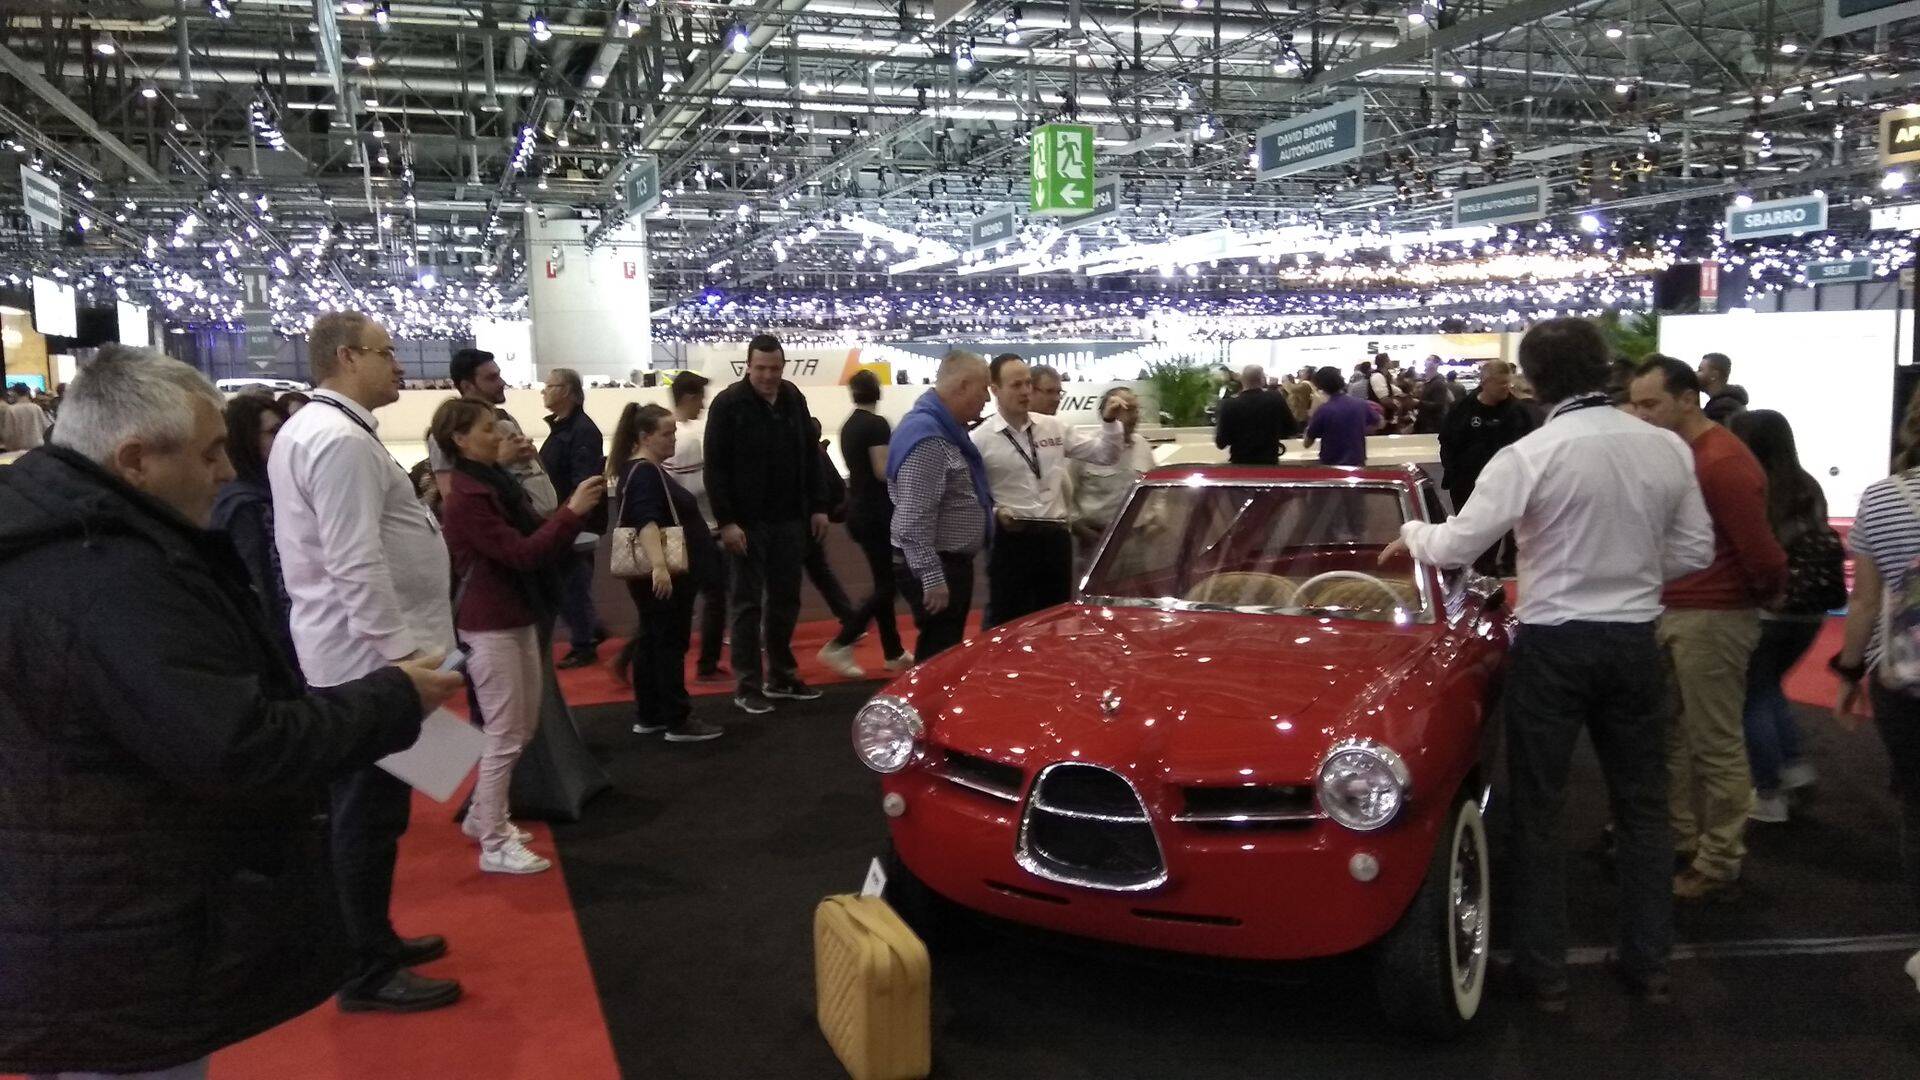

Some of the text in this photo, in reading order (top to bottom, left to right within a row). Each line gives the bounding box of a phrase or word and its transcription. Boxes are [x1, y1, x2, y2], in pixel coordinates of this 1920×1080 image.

[1277, 119, 1336, 147] DAVID BROWN
[1279, 136, 1334, 161] AUTOMOTIVE
[1744, 208, 1807, 227] SBARRO
